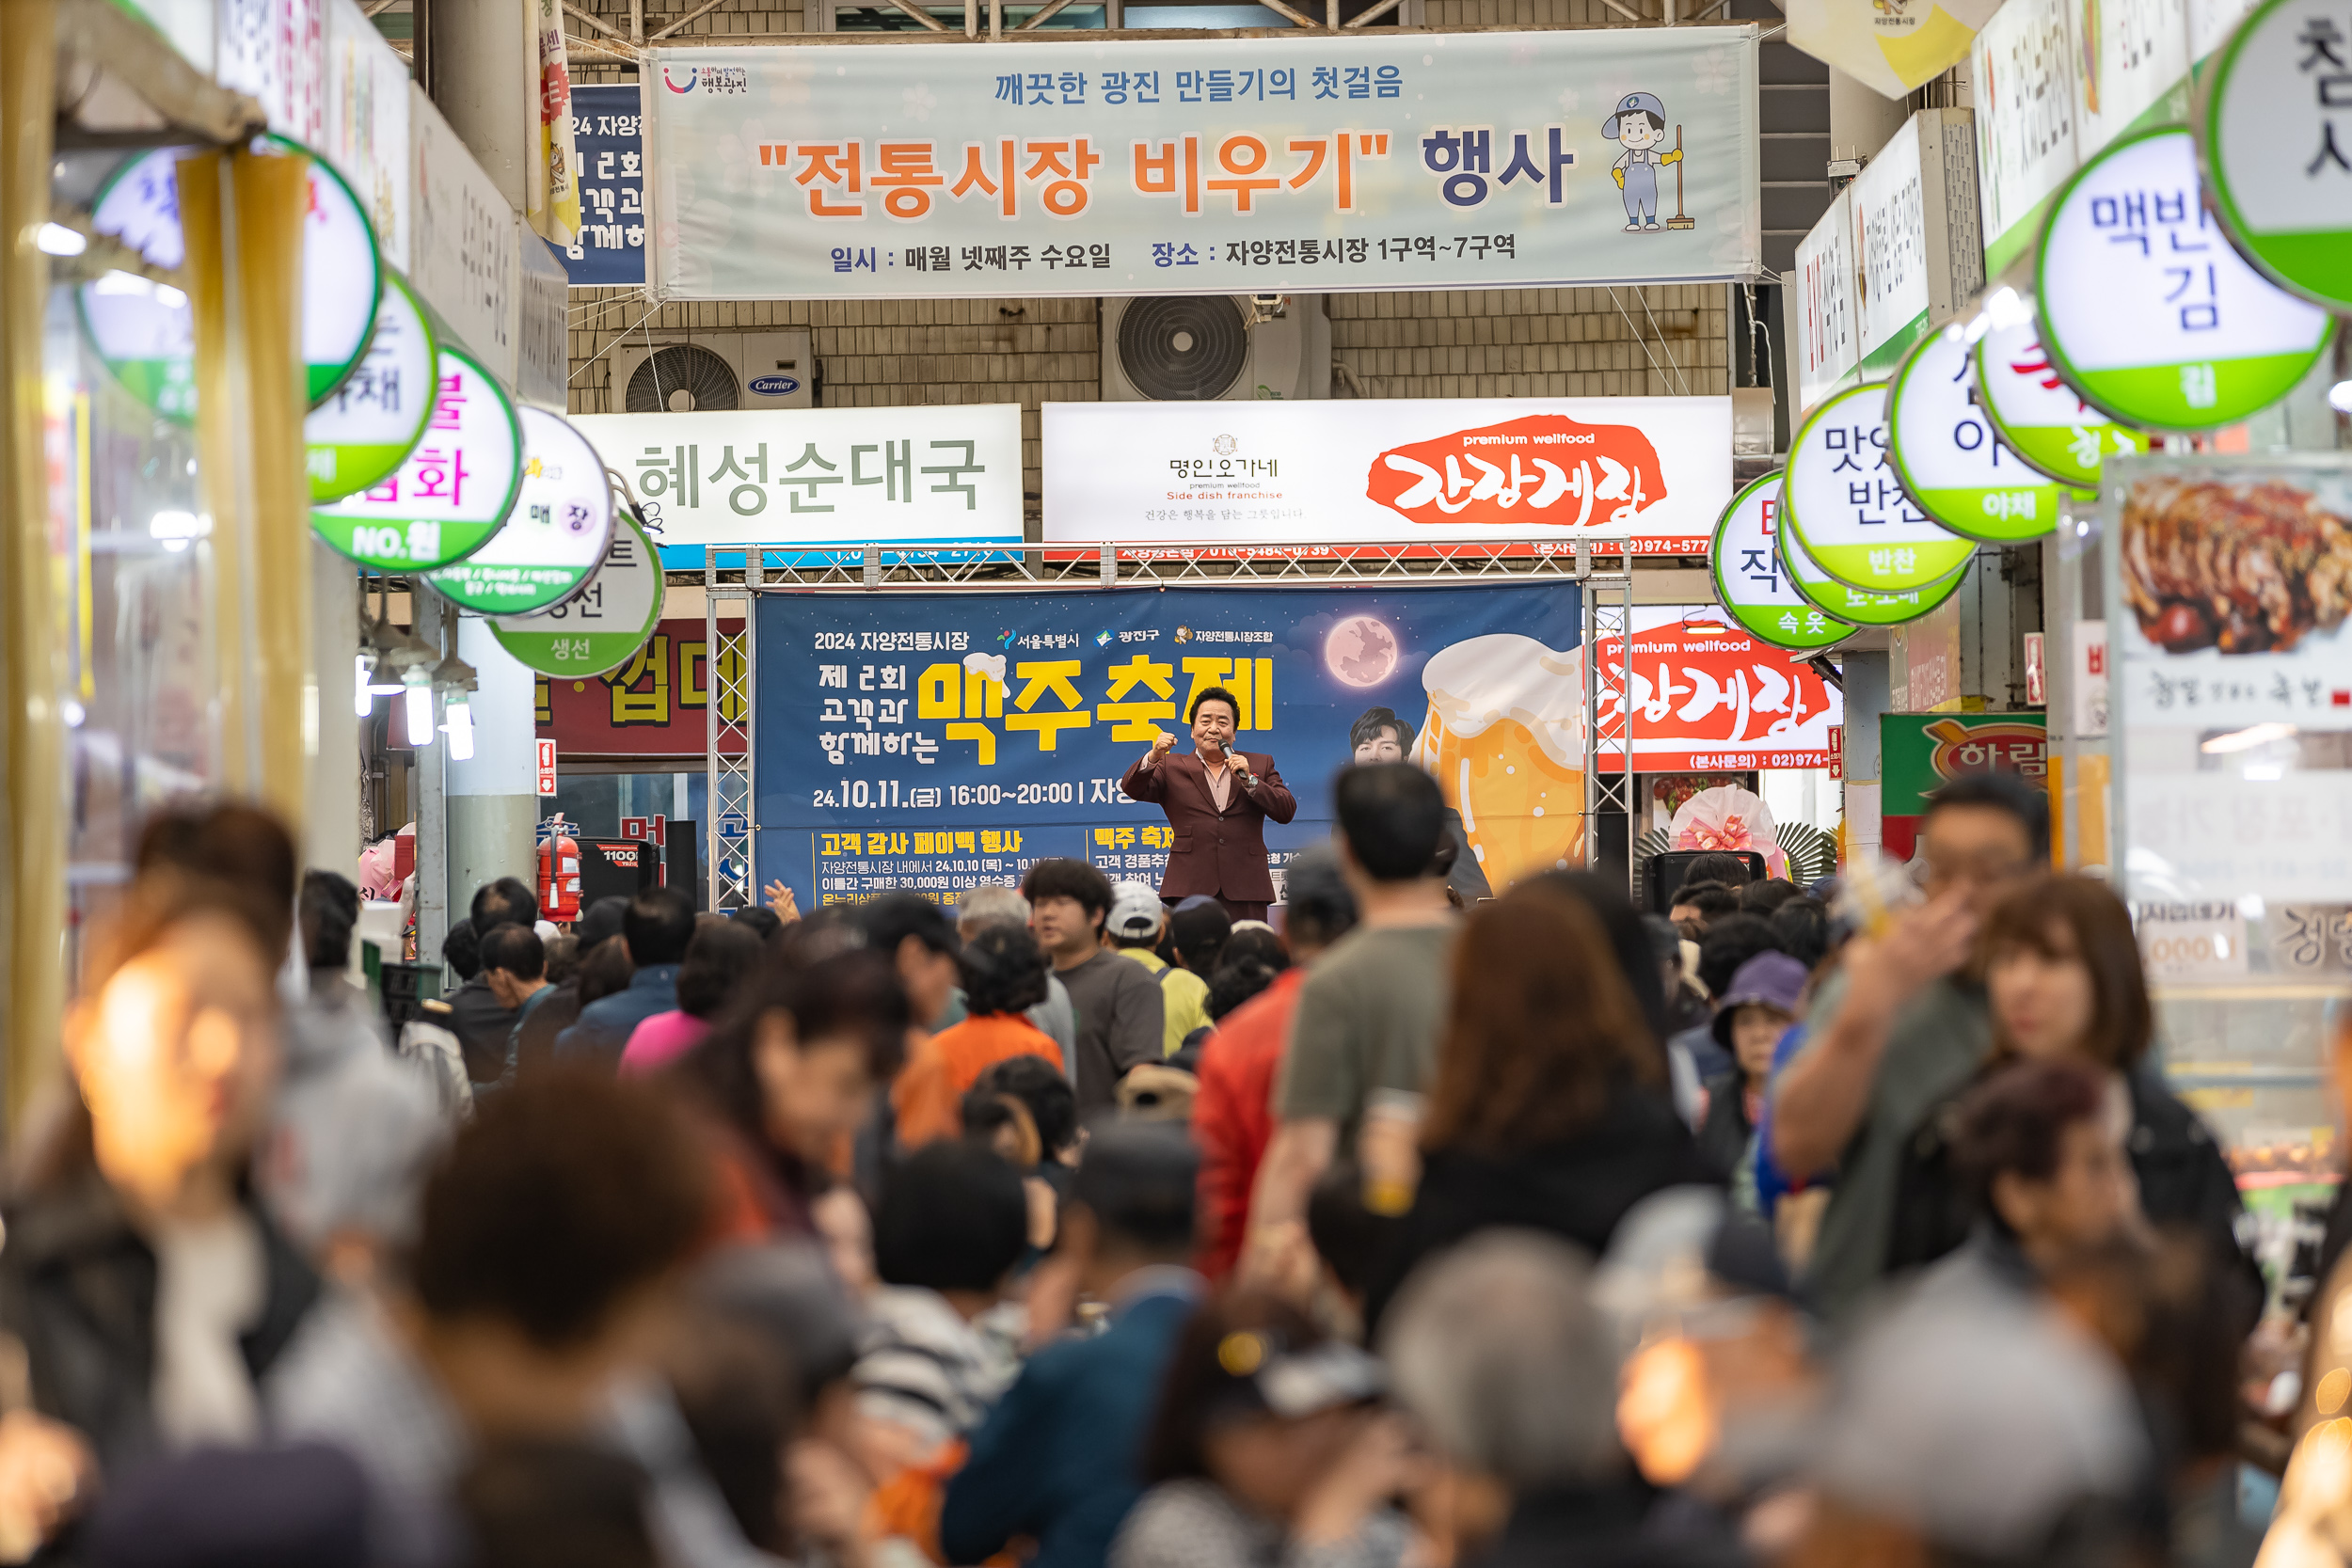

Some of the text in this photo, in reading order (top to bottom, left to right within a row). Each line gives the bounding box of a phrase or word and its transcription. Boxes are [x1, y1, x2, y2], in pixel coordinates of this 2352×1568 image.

[702, 76, 747, 94] 행복광진
[994, 65, 1403, 106] 깨끗한 광진 만들기의 첫걸음
[757, 127, 1575, 218] "전통시장 비우기" 행사
[830, 245, 877, 272] 일시
[905, 245, 951, 271] 매월
[961, 244, 1032, 271] 넷째주
[1041, 242, 1111, 269] 수요일
[1151, 242, 1199, 268] 장소
[1225, 236, 1369, 265] 자양전통시장
[1377, 233, 1517, 262] 1구역~7구역
[2164, 262, 2220, 333] 김
[755, 380, 793, 390] Carrier
[1463, 433, 1595, 447] premium wellfood
[636, 439, 985, 516] 혜성순대국
[1169, 459, 1278, 479] 명인오가네
[1189, 482, 1224, 490] premium
[1228, 491, 1282, 499] franchise
[1384, 452, 1646, 527] 간장게장
[1145, 509, 1179, 521] 건강은
[1184, 509, 1216, 521] 행복을
[1221, 508, 1243, 521] 담는
[1982, 492, 2037, 520] 야채
[1868, 547, 1916, 576] 반찬
[814, 631, 970, 651] 2024 자양전통시장
[1017, 633, 1079, 649] 서울특별시
[1119, 629, 1160, 642] 광진구
[1195, 629, 1274, 643] 자양전통시장조합
[1683, 640, 1751, 653] wellfood
[550, 638, 591, 661] 생선
[819, 698, 909, 732] 고객과
[917, 655, 1273, 766] 맥주 축제
[818, 730, 939, 766] 함께하는
[1959, 742, 2047, 776] 하림
[1690, 753, 1757, 769] (본사문의)
[1772, 752, 1828, 768] 02)974-
[949, 782, 1073, 806] 16:00~20:00
[820, 829, 1023, 856] 고객 감사 페이백 행사
[1094, 827, 1136, 850] 맥주
[821, 860, 895, 876] 자양전통시장
[897, 859, 932, 875] 내에서
[935, 859, 978, 873] 24.10.10
[981, 858, 1003, 873] (목)
[1095, 854, 1121, 869] 고객
[821, 877, 859, 891] 이틀간
[861, 876, 897, 891] 구매한
[899, 876, 949, 891] 30,000원
[952, 876, 977, 890] 이상
[979, 875, 1016, 889] 영수증
